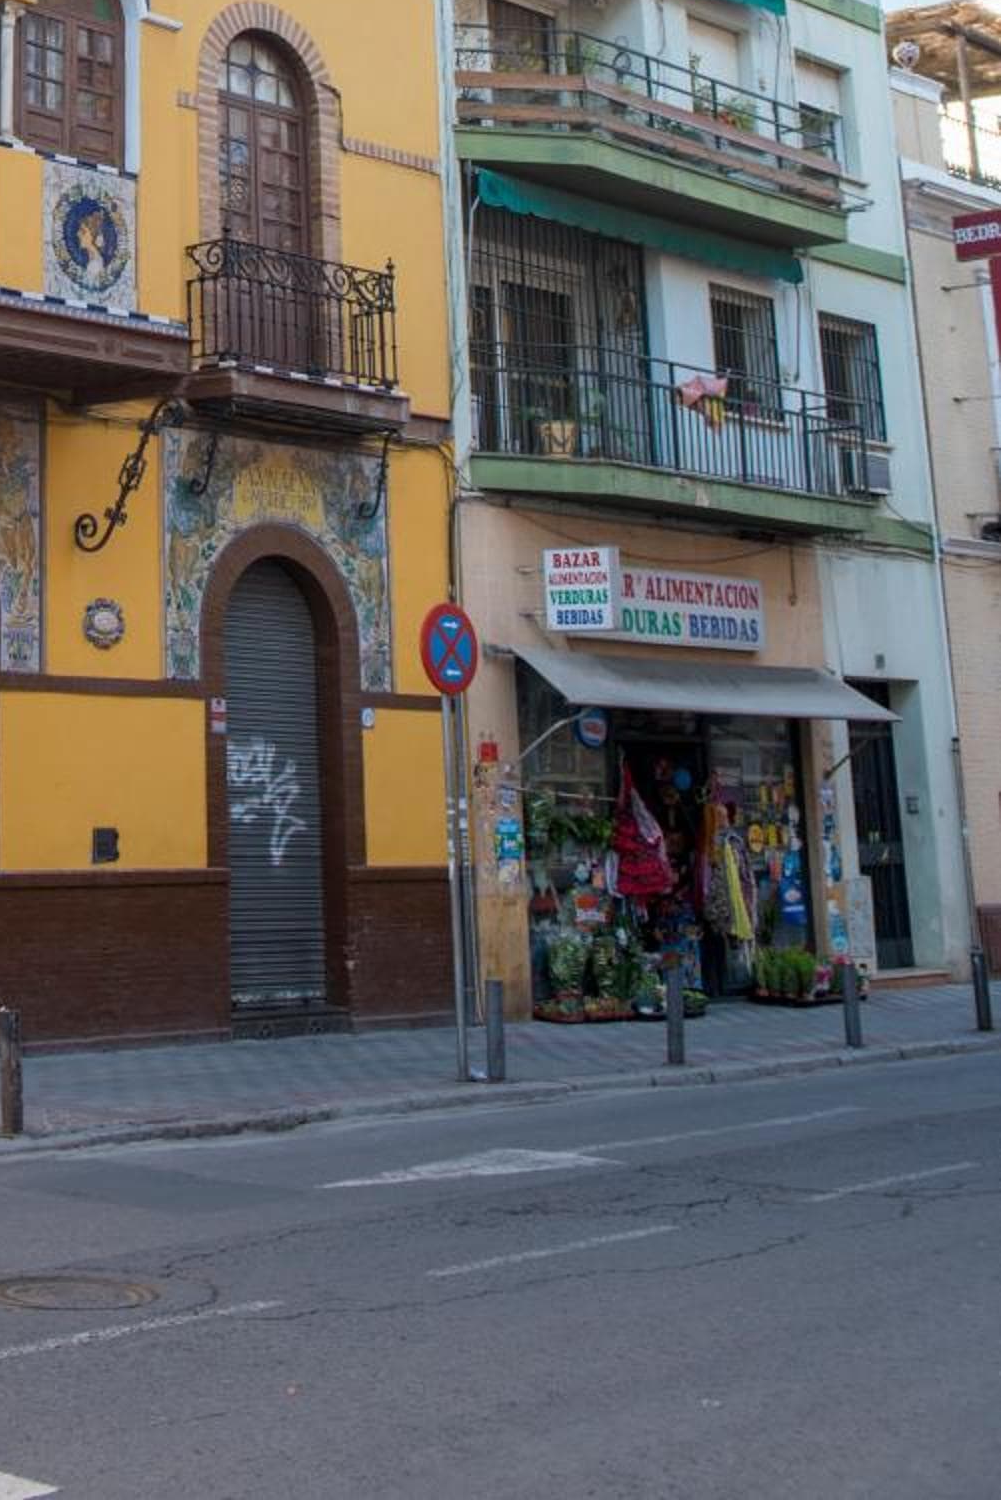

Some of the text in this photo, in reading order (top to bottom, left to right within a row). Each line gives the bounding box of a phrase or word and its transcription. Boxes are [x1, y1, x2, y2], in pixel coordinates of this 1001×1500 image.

[953, 223, 1001, 243] BEDR
[552, 552, 600, 568] BAZAR
[550, 588, 608, 606] VERDURAS
[645, 576, 759, 610] ALIMENTACION
[557, 609, 603, 626] BEBIDAS
[622, 608, 759, 642] DURAS BEBIDAS
